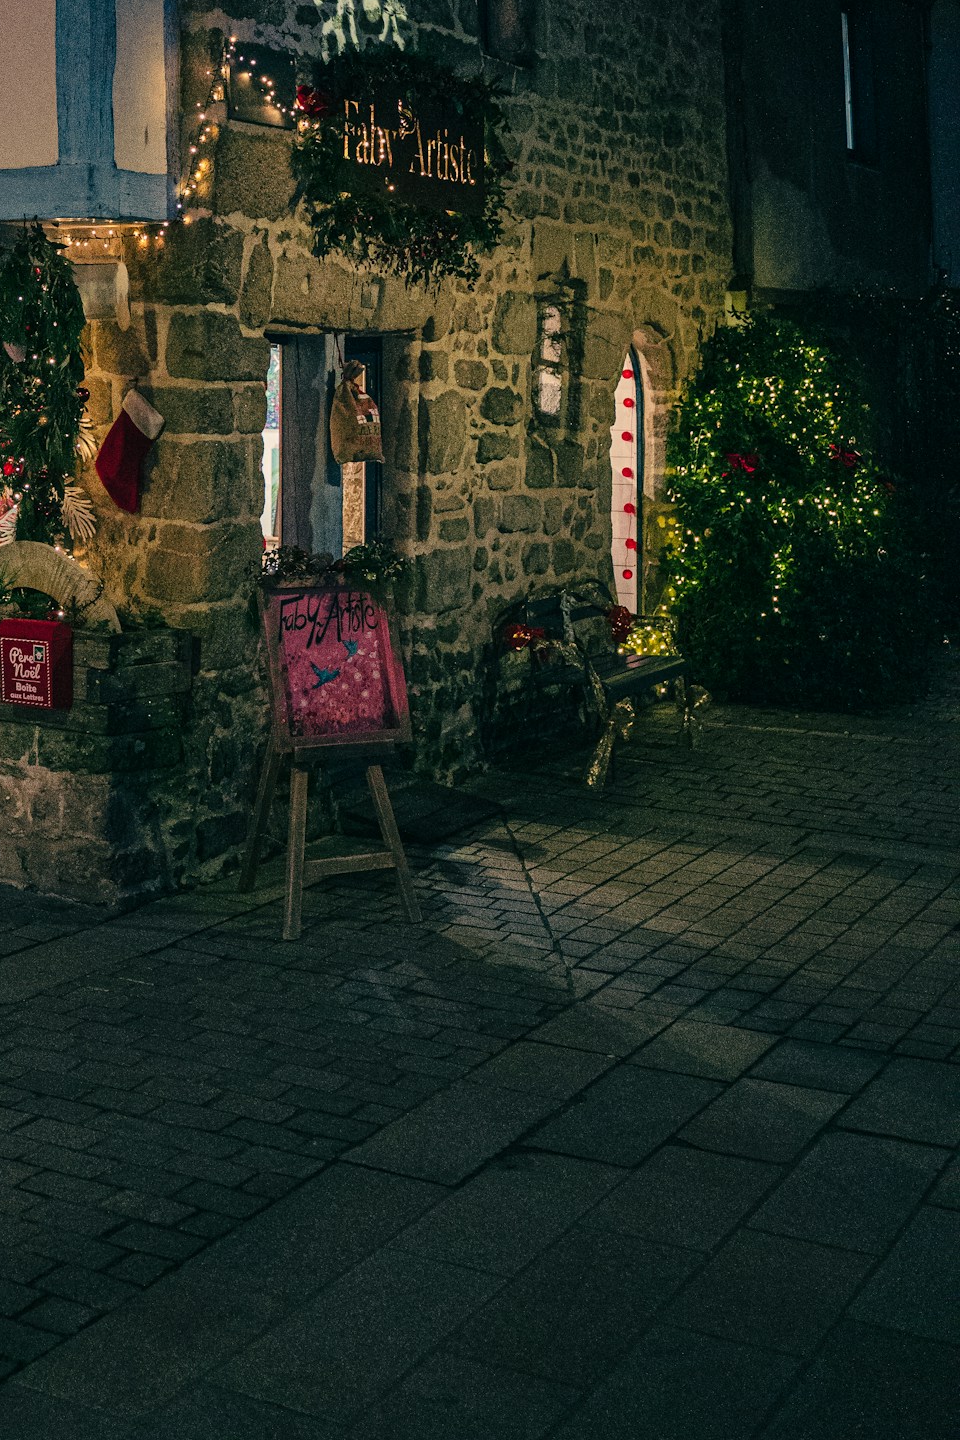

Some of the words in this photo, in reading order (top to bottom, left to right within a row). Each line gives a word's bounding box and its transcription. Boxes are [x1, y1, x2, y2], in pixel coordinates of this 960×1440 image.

[408, 117, 478, 186] Artiste
[278, 594, 323, 649] Faby
[316, 592, 379, 644] Artiste
[9, 647, 35, 664] Père
[13, 662, 41, 679] Noël
[15, 682, 38, 693] Boîte
[22, 693, 44, 702] Lettres
